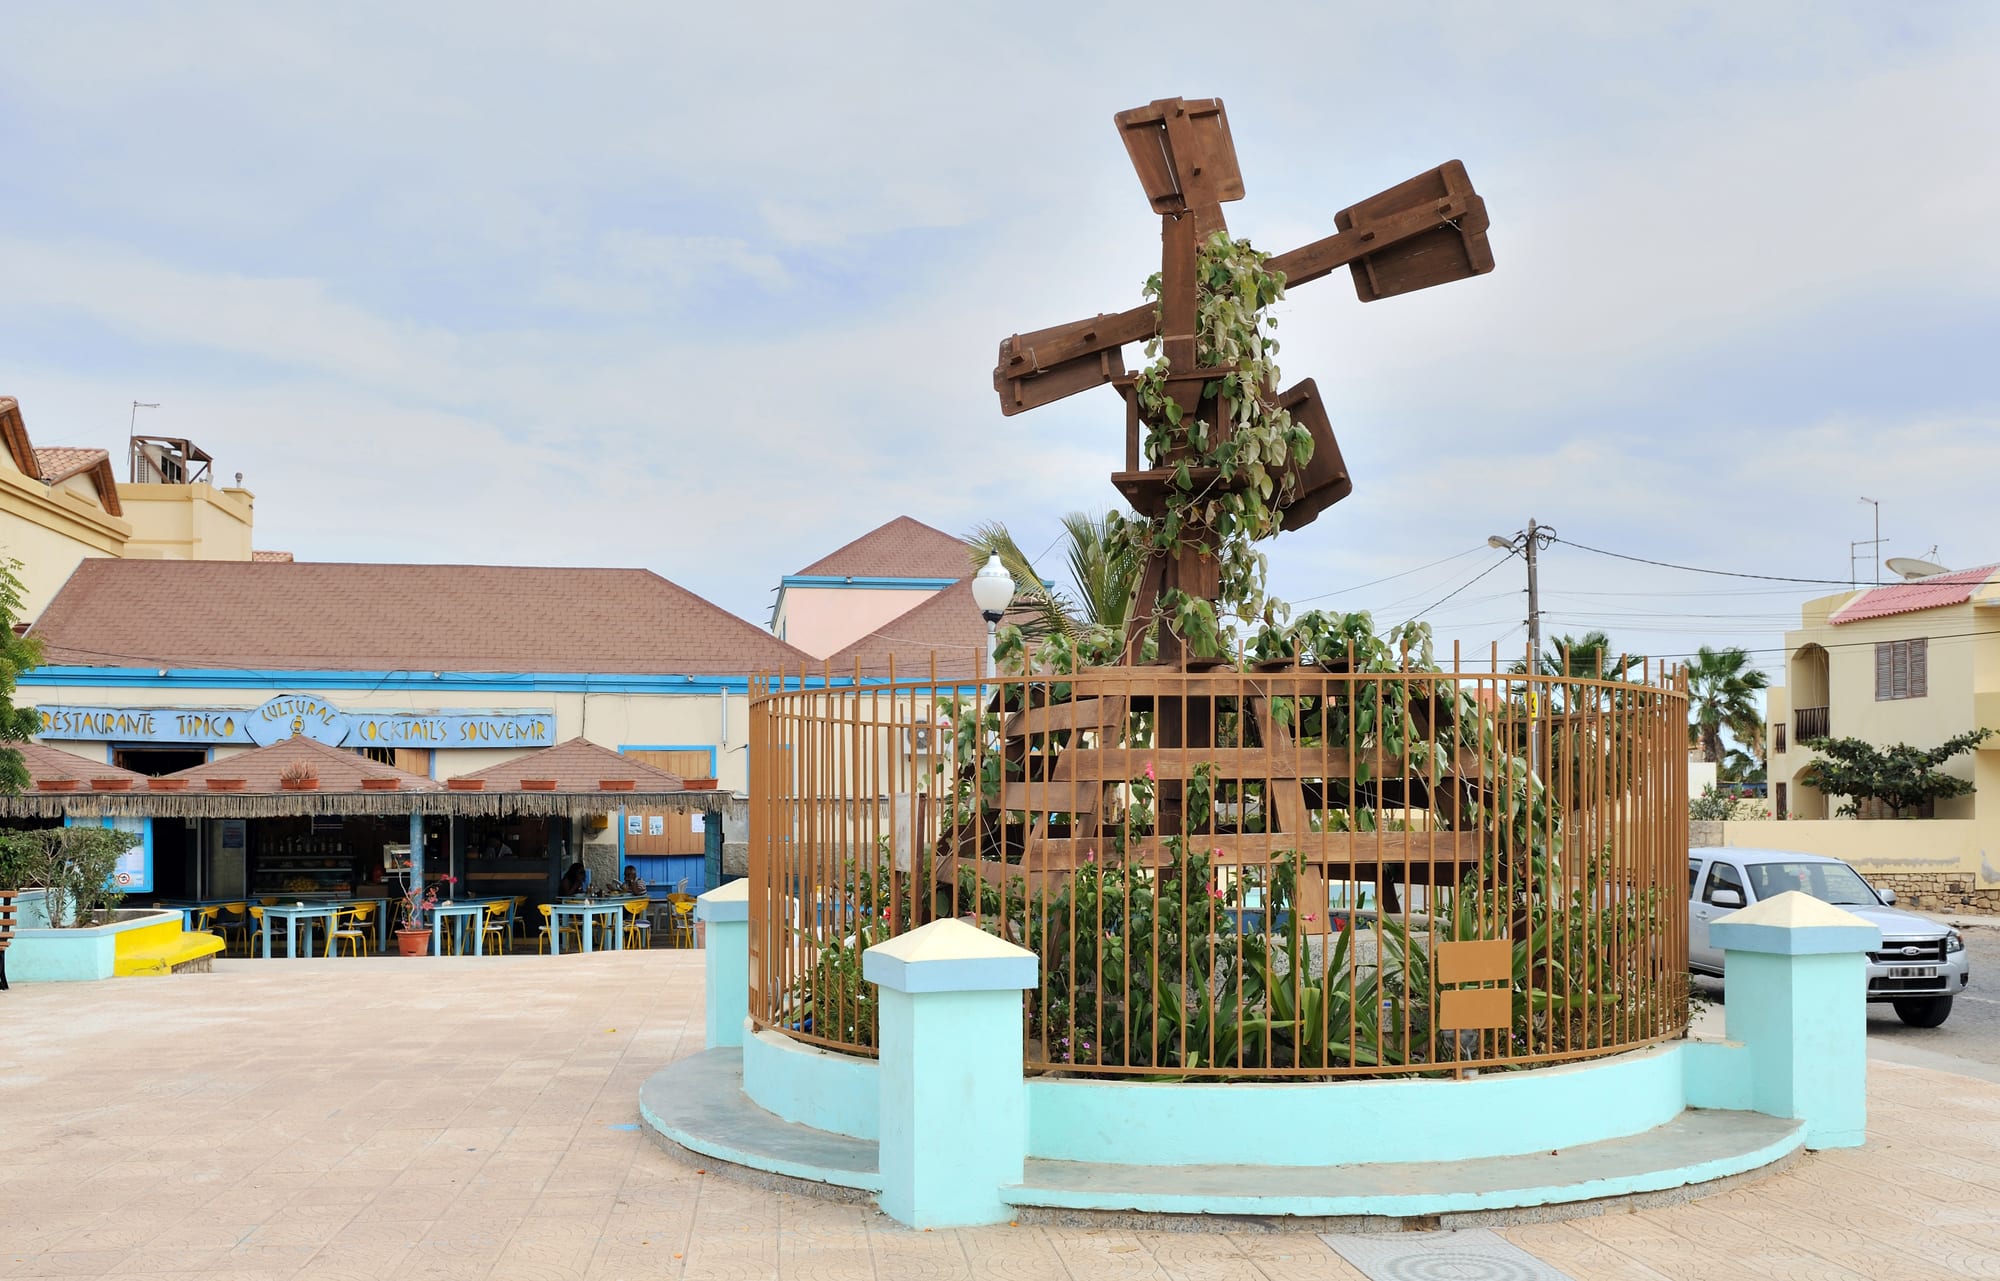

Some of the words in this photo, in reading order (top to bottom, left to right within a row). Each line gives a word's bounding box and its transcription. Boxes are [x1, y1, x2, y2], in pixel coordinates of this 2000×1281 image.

[41, 711, 156, 735] RESTAURANTE
[261, 700, 335, 726] CULTURAL
[460, 718, 545, 741] SOUVENIR
